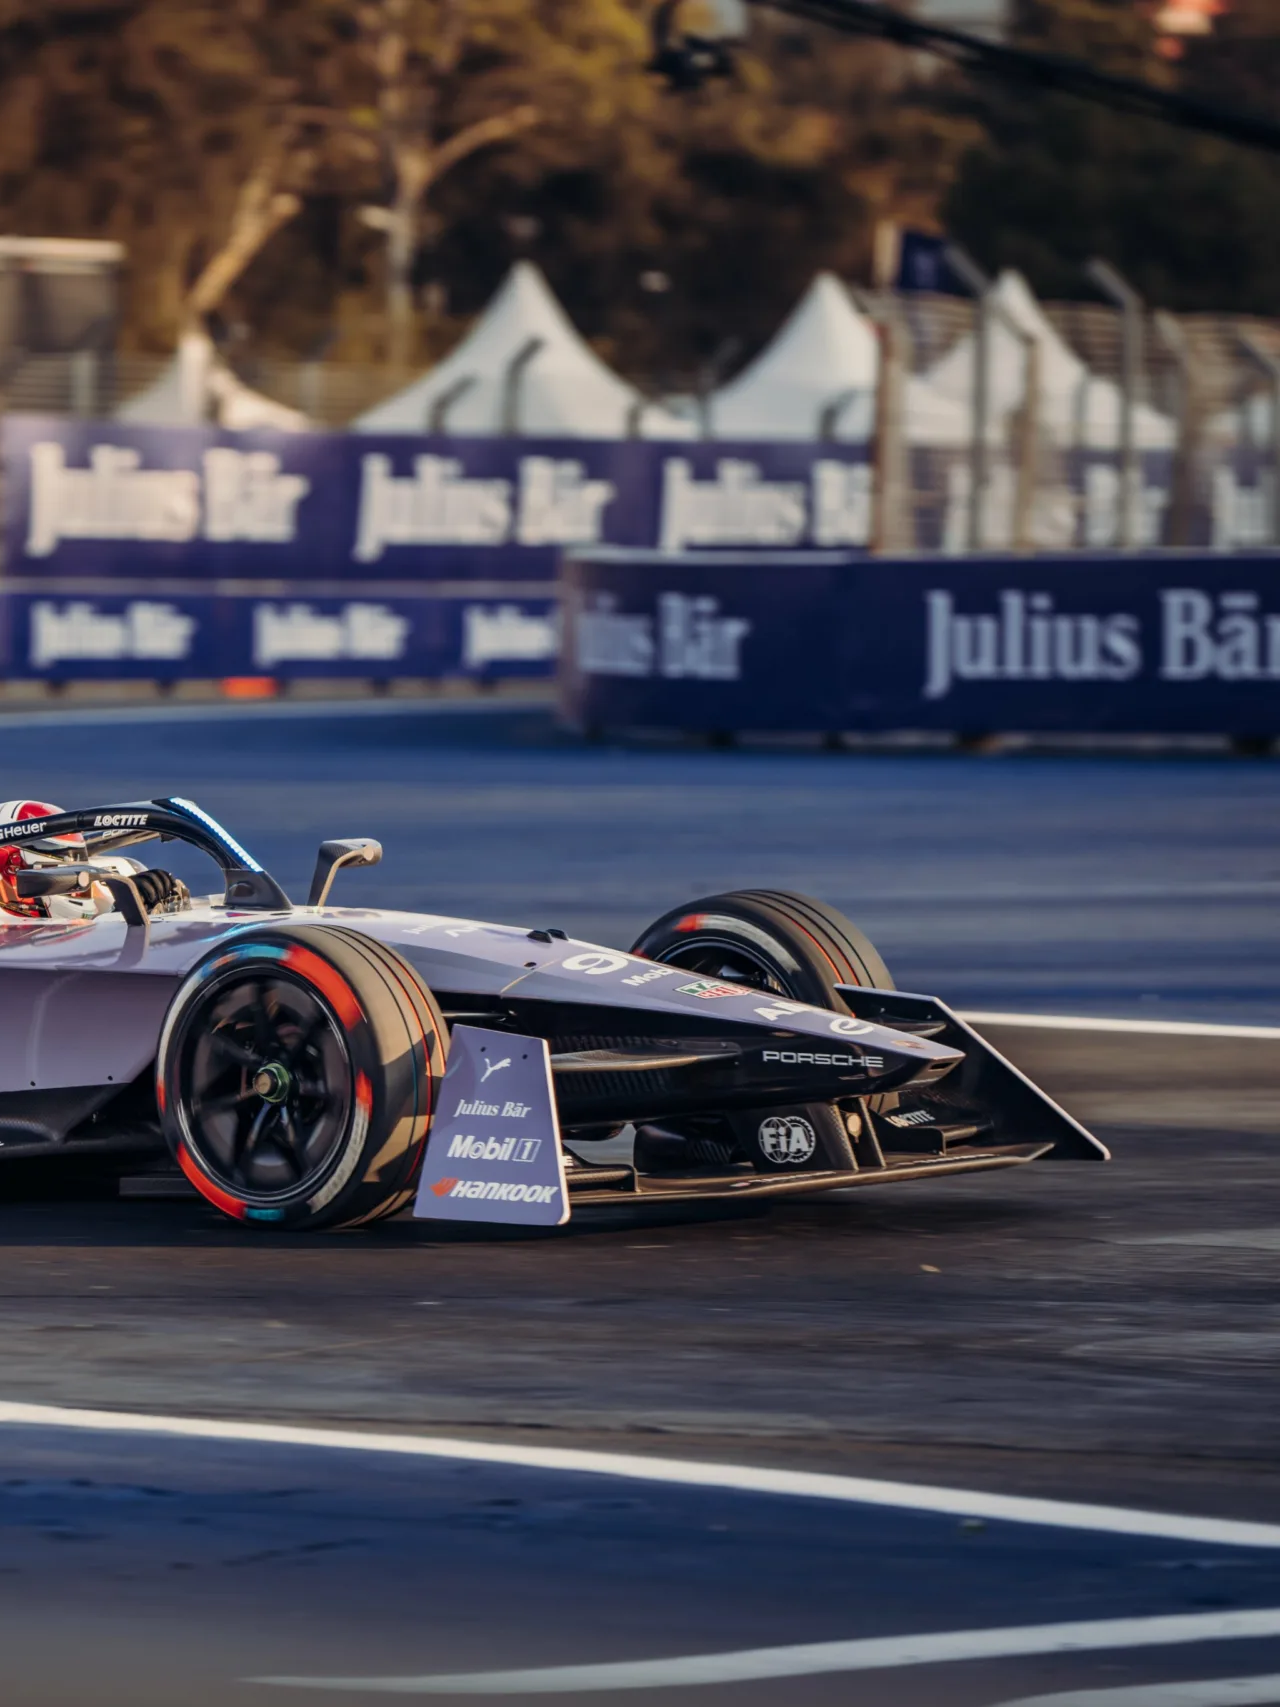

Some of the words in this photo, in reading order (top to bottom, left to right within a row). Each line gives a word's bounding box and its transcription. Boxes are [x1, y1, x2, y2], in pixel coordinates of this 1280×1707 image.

[923, 588, 1140, 699] Julius
[94, 814, 149, 827] LOCTITE
[621, 968, 675, 987] Mob
[763, 1050, 884, 1068] PORSCHE
[452, 1098, 500, 1117] Julius
[884, 1110, 936, 1128] LOCTITE
[447, 1134, 517, 1161] Mobil
